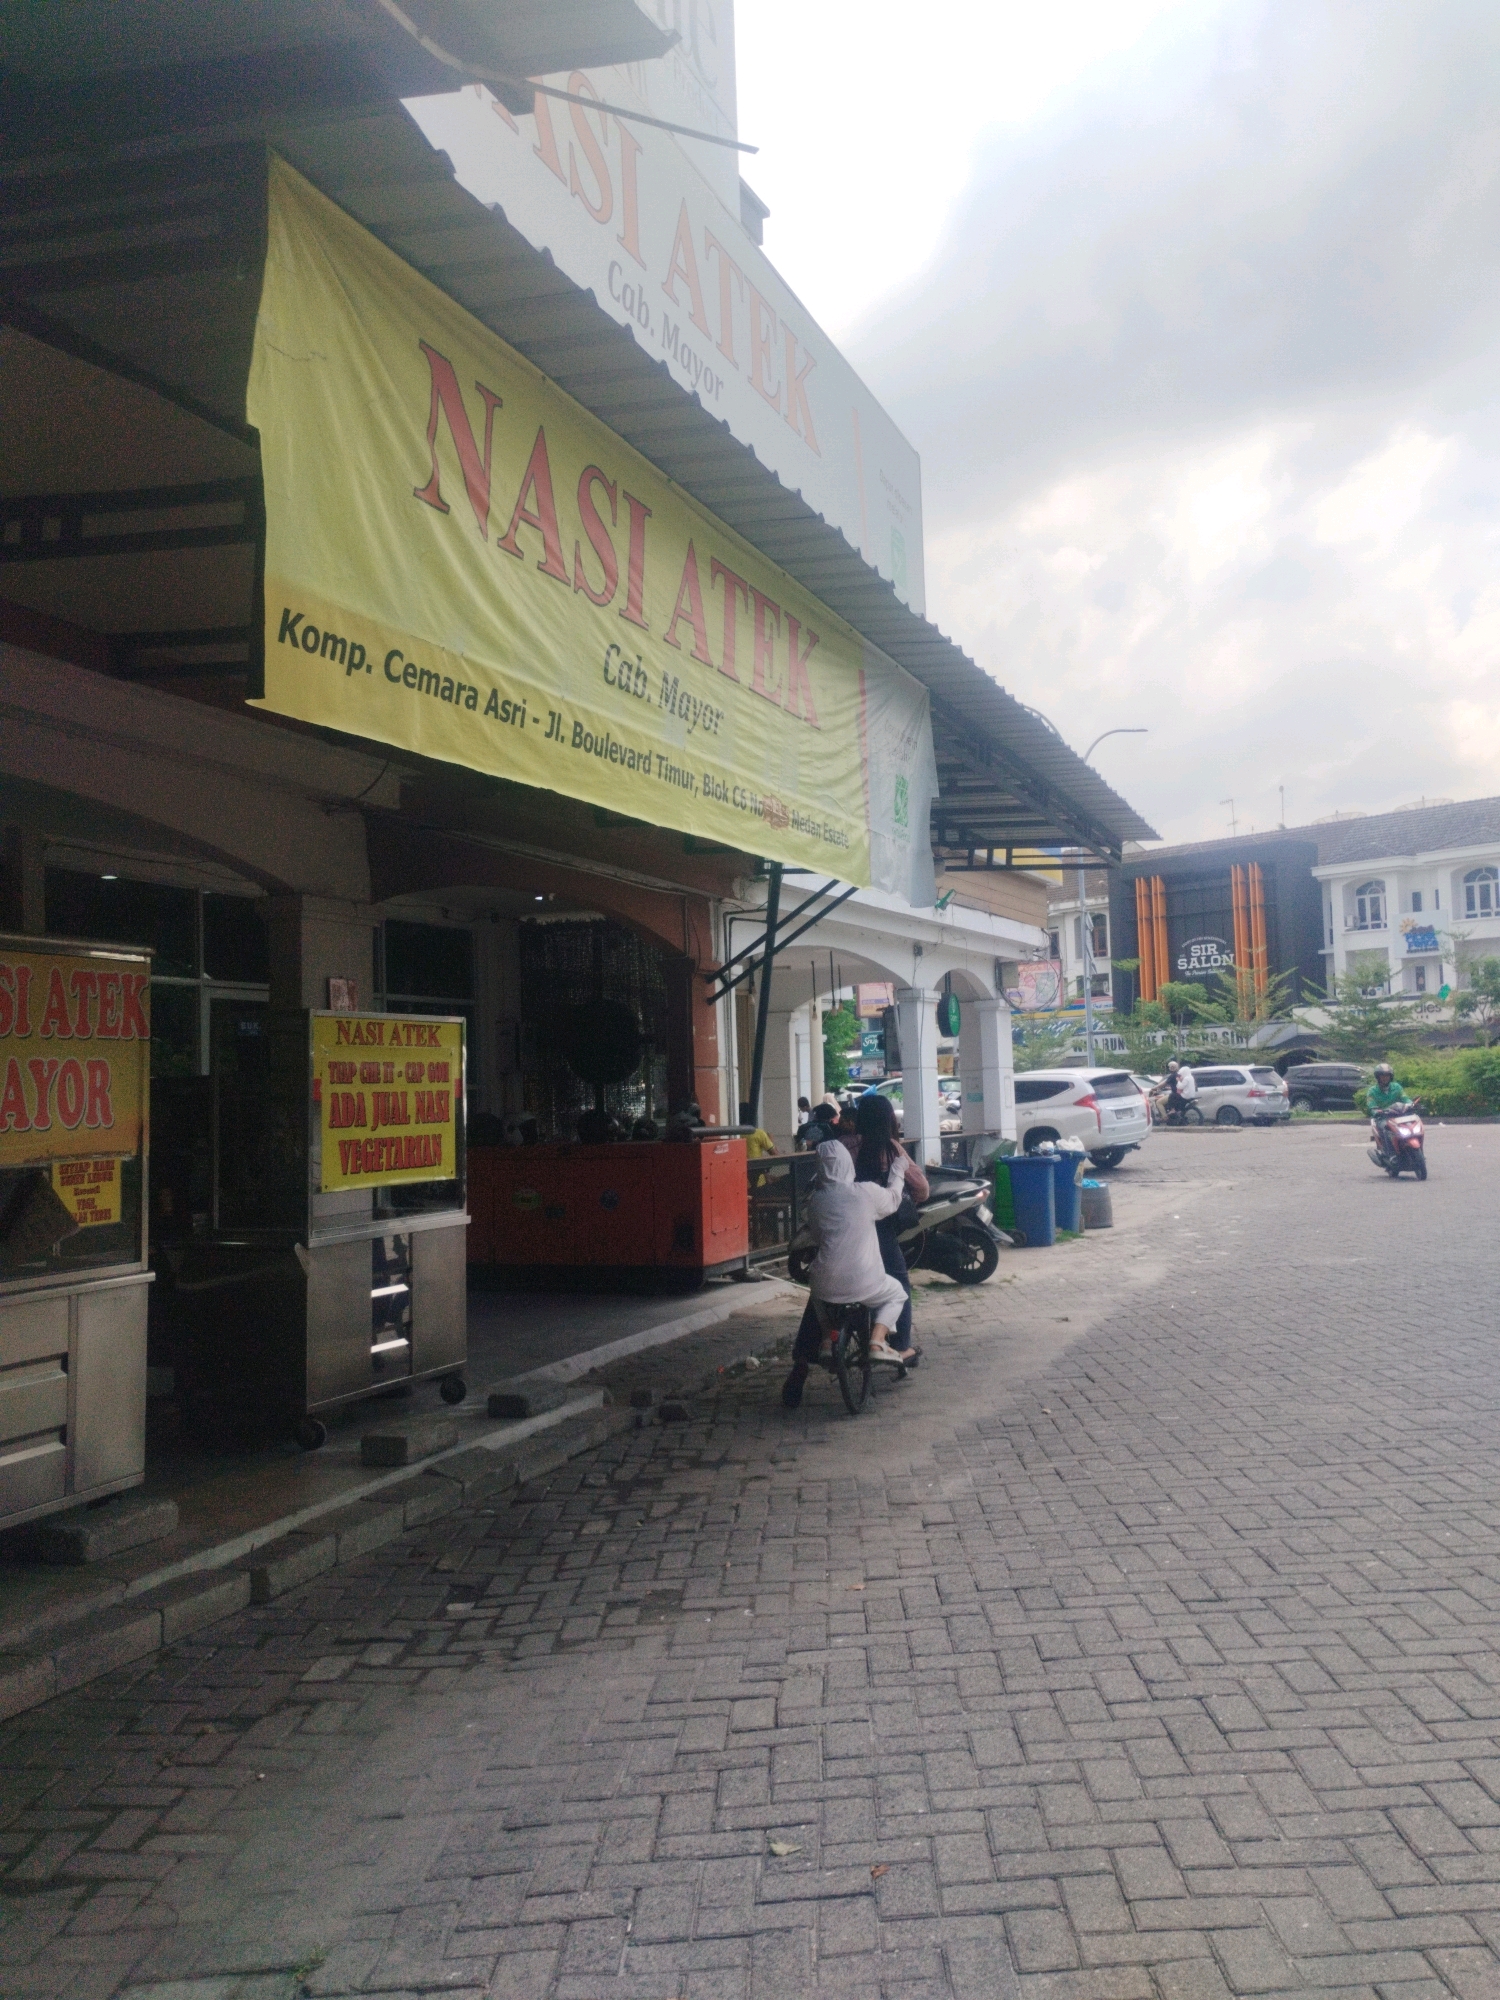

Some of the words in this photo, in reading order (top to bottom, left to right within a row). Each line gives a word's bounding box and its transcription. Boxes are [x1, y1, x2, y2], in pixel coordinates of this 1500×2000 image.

[608, 260, 654, 337] Cab.
[662, 311, 724, 402] Mayor
[661, 196, 821, 458] ATEK
[413, 338, 652, 631] NASI
[663, 537, 821, 731] ATEK
[603, 643, 651, 703] Cab.
[657, 670, 725, 735] Mayor
[278, 607, 372, 676] Komp.
[384, 649, 479, 711] Cemara
[484, 687, 527, 729] Asri
[544, 710, 565, 744] Jl.
[571, 721, 652, 775] Boulevard
[656, 753, 699, 798] Timur,
[702, 773, 729, 804] Blok
[732, 785, 746, 811] C6
[791, 809, 821, 839] Medan
[823, 821, 850, 849] Estate
[1177, 953, 1235, 970] SALON
[1191, 943, 1219, 957] SIR
[40, 966, 151, 1039] ATEK
[336, 1021, 384, 1046] NASI
[389, 1023, 442, 1047] ATEK
[0, 1057, 114, 1131] AYOR
[405, 1062, 425, 1084] CAP
[329, 1093, 367, 1128] ADA
[371, 1091, 410, 1131] JUAL
[415, 1090, 450, 1124] NASI
[338, 1134, 443, 1175] VEGETARIAN
